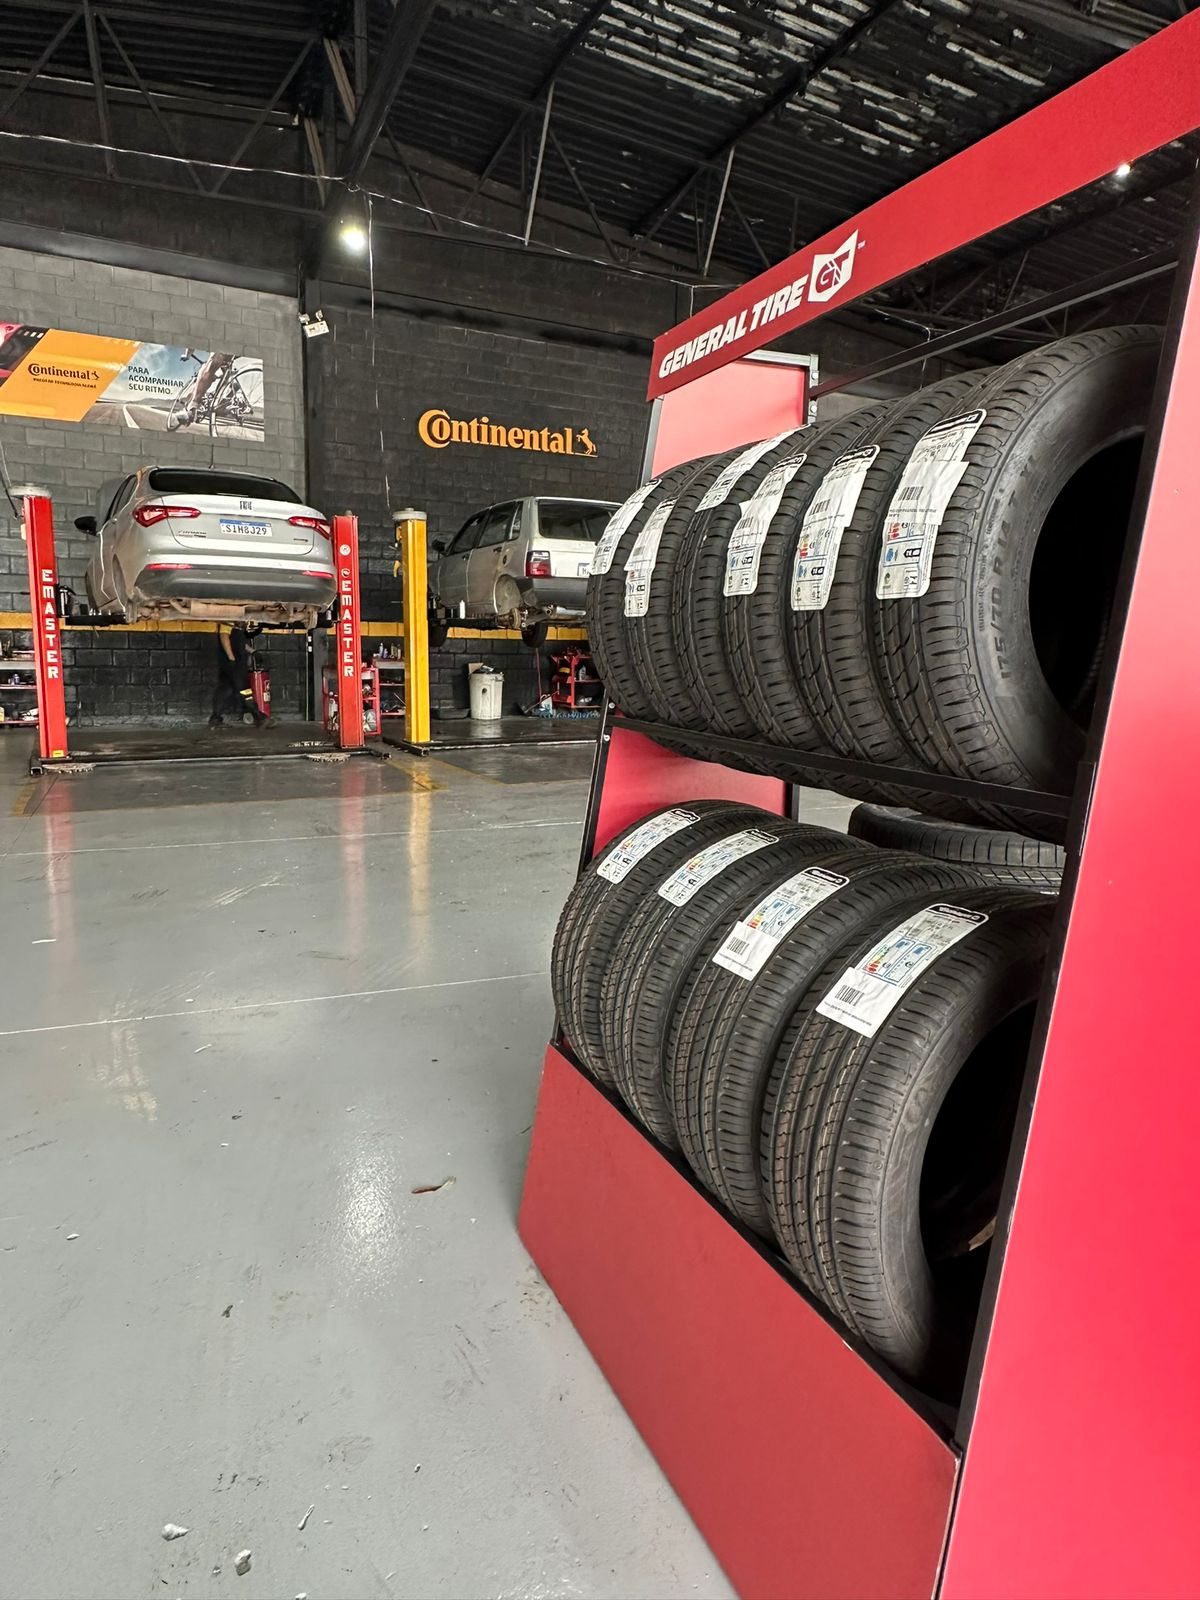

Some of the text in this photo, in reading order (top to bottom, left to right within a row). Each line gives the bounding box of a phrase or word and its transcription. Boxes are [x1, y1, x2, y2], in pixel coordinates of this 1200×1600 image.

[659, 309, 748, 379] GENERAL
[750, 274, 809, 332] TIRE
[28, 363, 91, 380] Continental
[128, 366, 149, 375] PARA
[128, 375, 184, 388] ACOMPANHAR
[128, 383, 173, 395] SEU RITMO.
[418, 409, 575, 455] Continental
